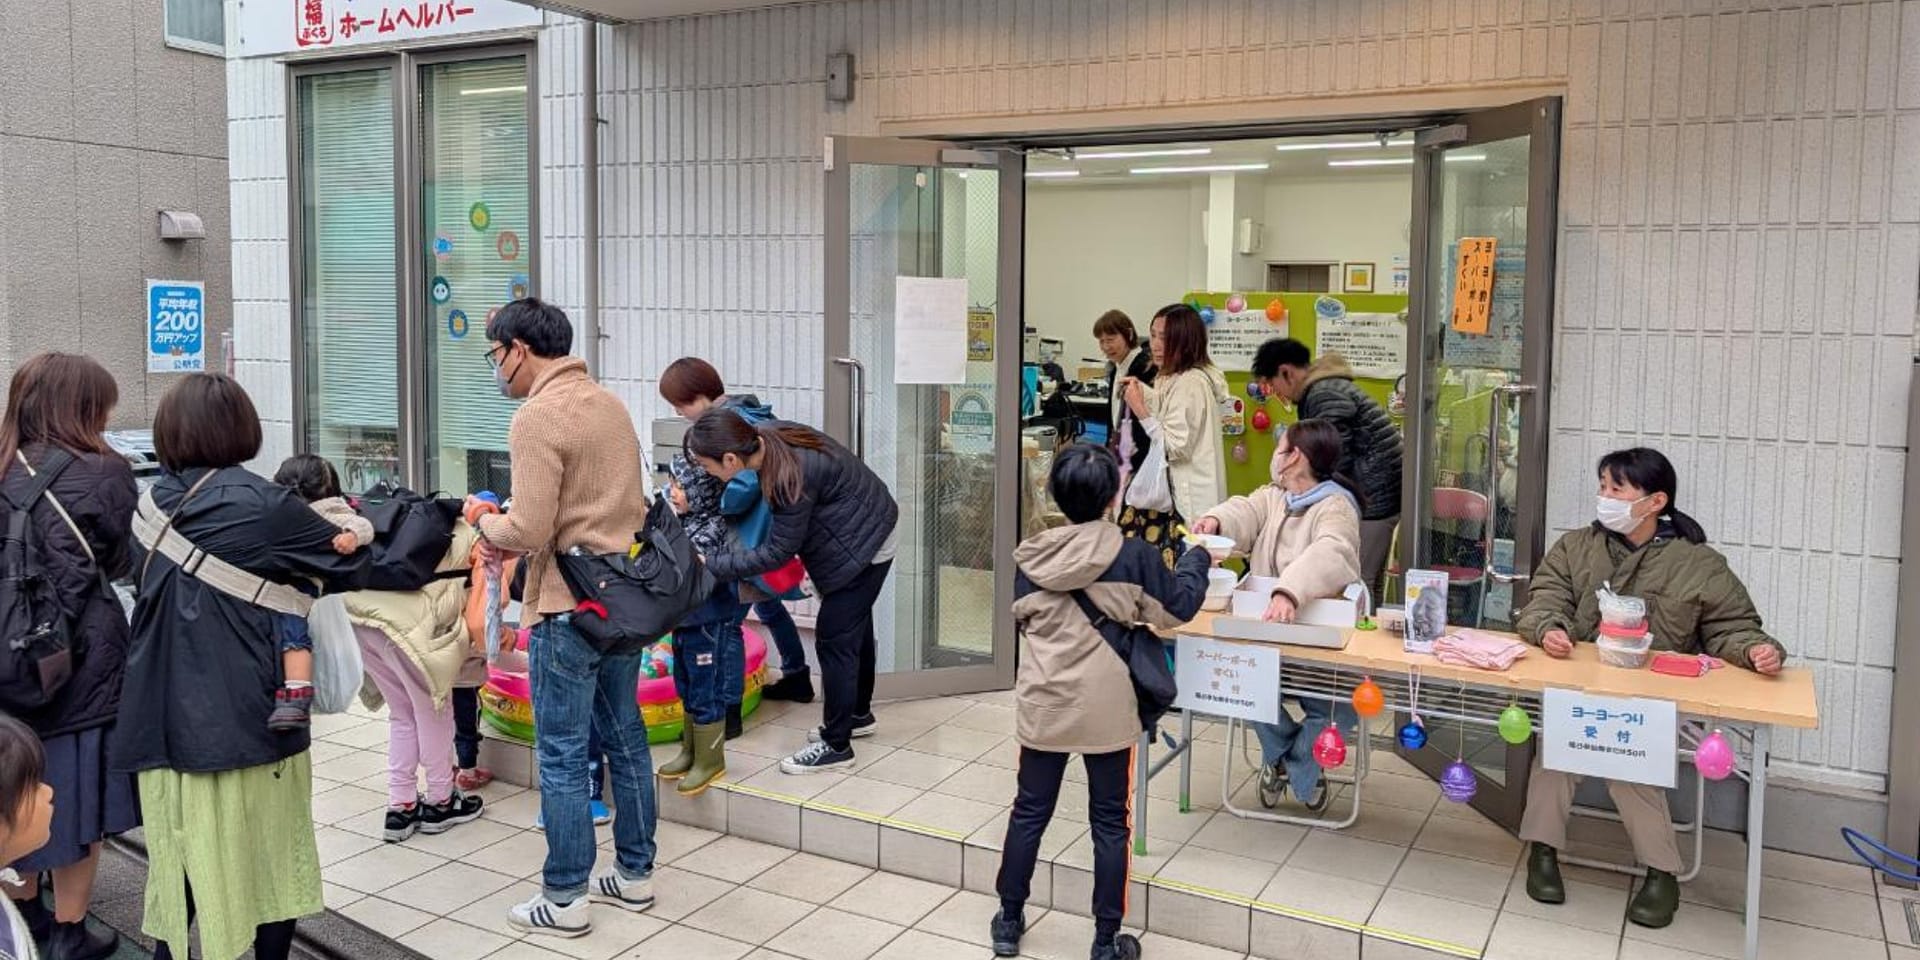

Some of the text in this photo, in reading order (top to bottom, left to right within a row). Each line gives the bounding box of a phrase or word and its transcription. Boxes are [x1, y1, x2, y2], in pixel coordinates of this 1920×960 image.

[155, 310, 199, 331] 200
[155, 332, 198, 344] 万円アップ
[1196, 649, 1257, 667] スーパーボール
[1571, 706, 1644, 725] ヨーヨーつり
